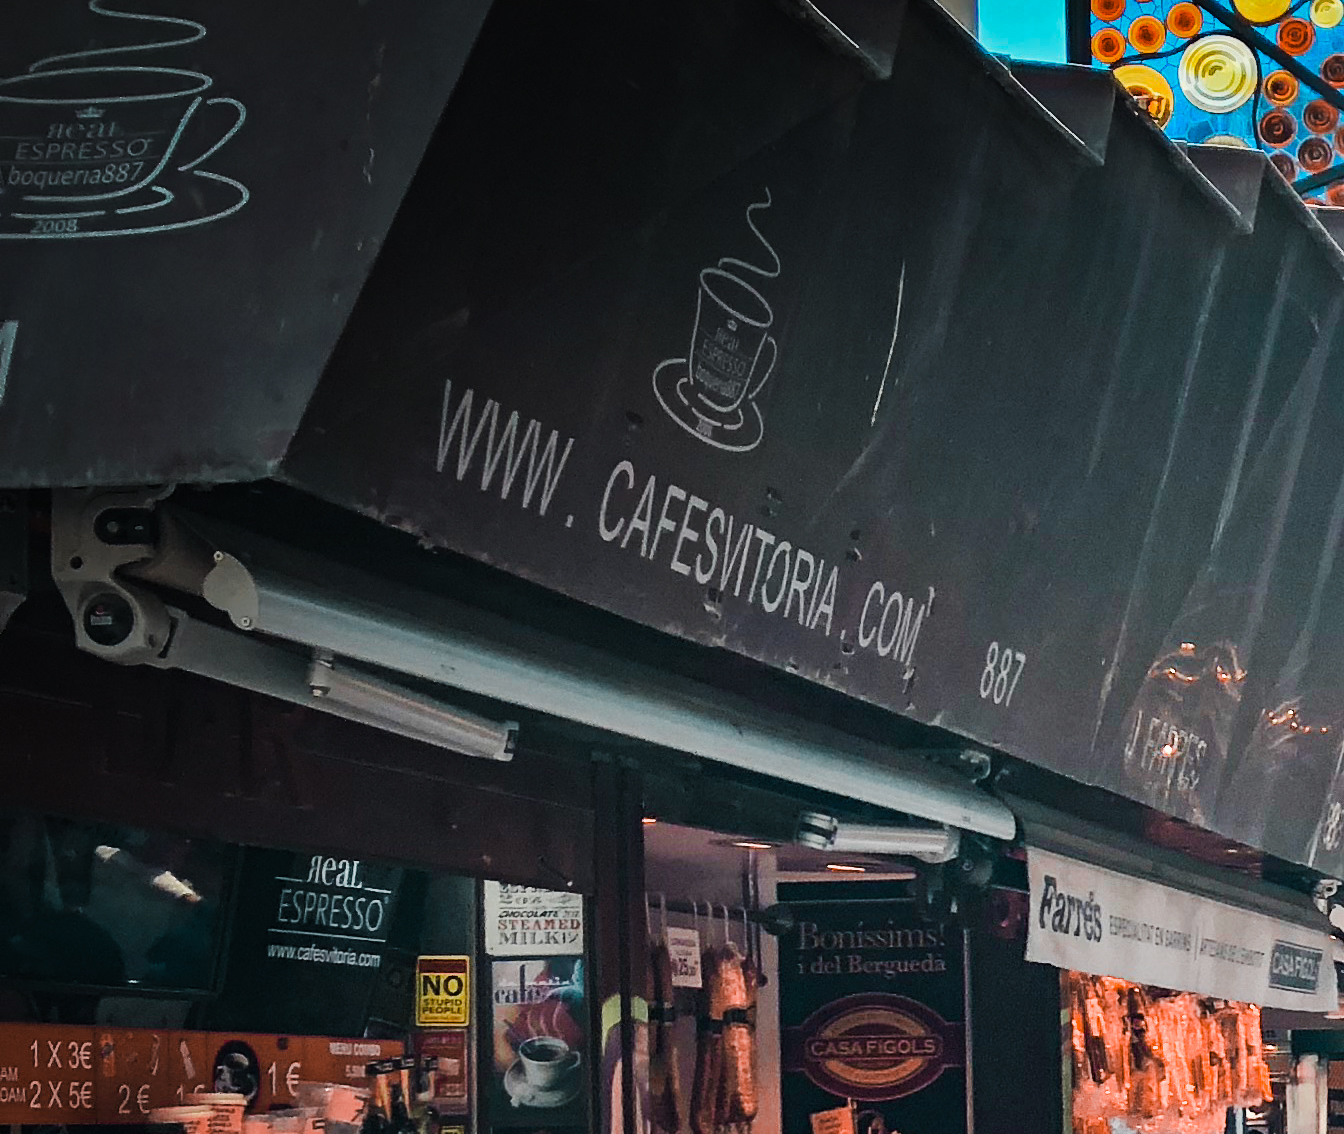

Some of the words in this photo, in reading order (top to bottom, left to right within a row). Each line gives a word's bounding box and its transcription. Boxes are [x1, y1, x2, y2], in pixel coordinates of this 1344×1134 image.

[15, 138, 148, 160] ESPRESSO
[8, 162, 143, 190] boqueria887
[30, 219, 79, 233] 2008
[979, 641, 1026, 707] 887
[278, 889, 384, 932] ESPRESSO
[1039, 874, 1102, 943] Farrés
[498, 919, 580, 931] STEAMED
[499, 931, 559, 945] MILK
[268, 943, 381, 968] www.cafesvitoria.com
[810, 954, 841, 974] del
[422, 975, 463, 996] NO
[422, 1006, 462, 1014] PEOPLE
[423, 998, 462, 1006] STUPID
[30, 1039, 38, 1068] 1
[68, 1041, 92, 1069] 3€
[811, 1040, 863, 1056] CASA
[866, 1038, 936, 1055] FIGOLS
[29, 1080, 42, 1109] 2
[69, 1081, 93, 1109] 5€
